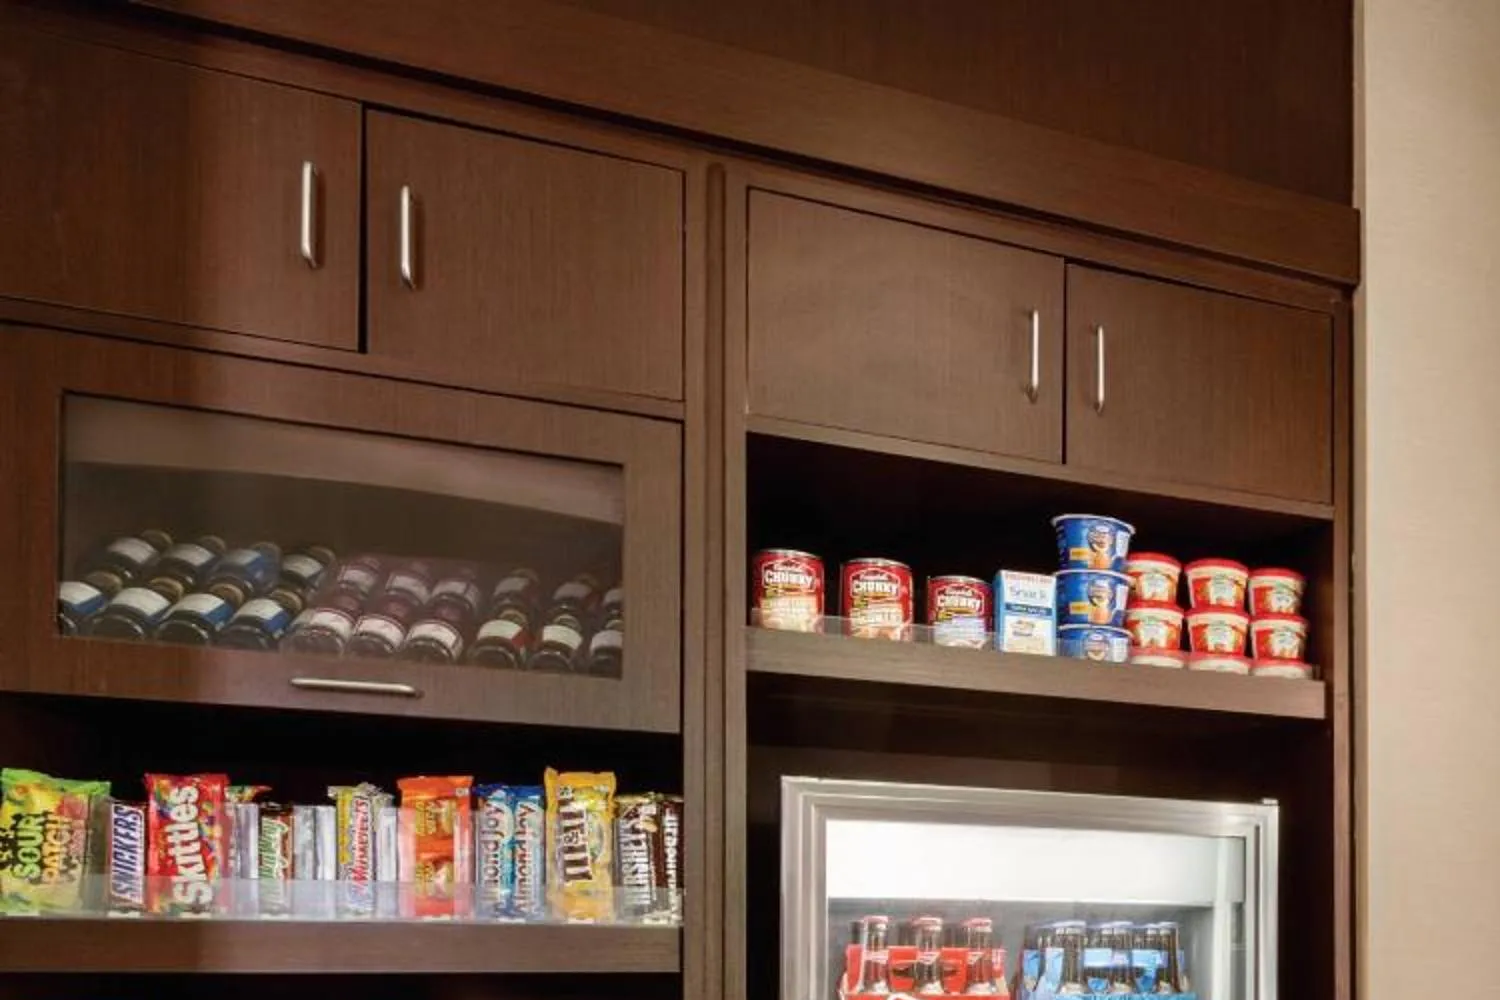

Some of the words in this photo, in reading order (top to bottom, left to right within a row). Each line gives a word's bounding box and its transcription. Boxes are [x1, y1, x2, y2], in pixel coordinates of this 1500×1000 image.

[13, 813, 44, 879] SOUR
[113, 803, 144, 898] SNICKERS
[164, 783, 214, 904] Skittles
